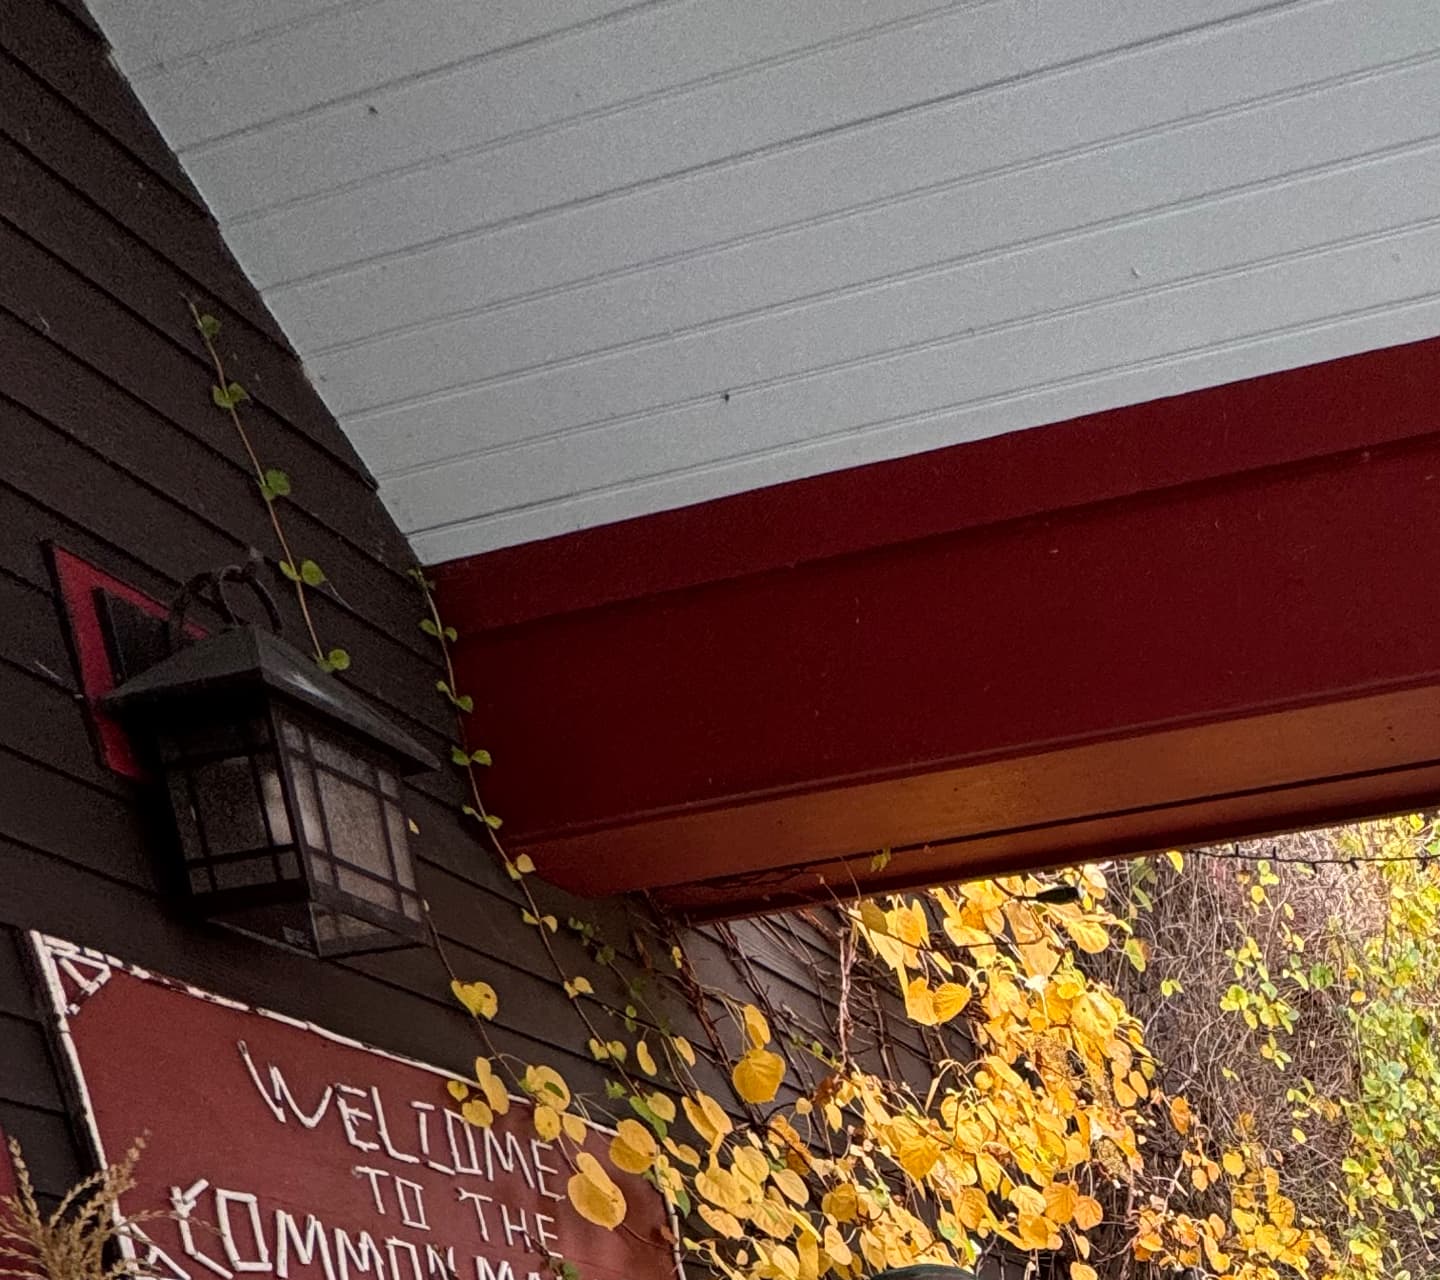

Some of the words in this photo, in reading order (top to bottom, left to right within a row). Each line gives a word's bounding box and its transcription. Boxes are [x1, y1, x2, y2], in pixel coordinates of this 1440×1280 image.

[236, 1038, 565, 1201] WELCOME
[356, 1165, 430, 1229] TO
[457, 1186, 563, 1258] THE
